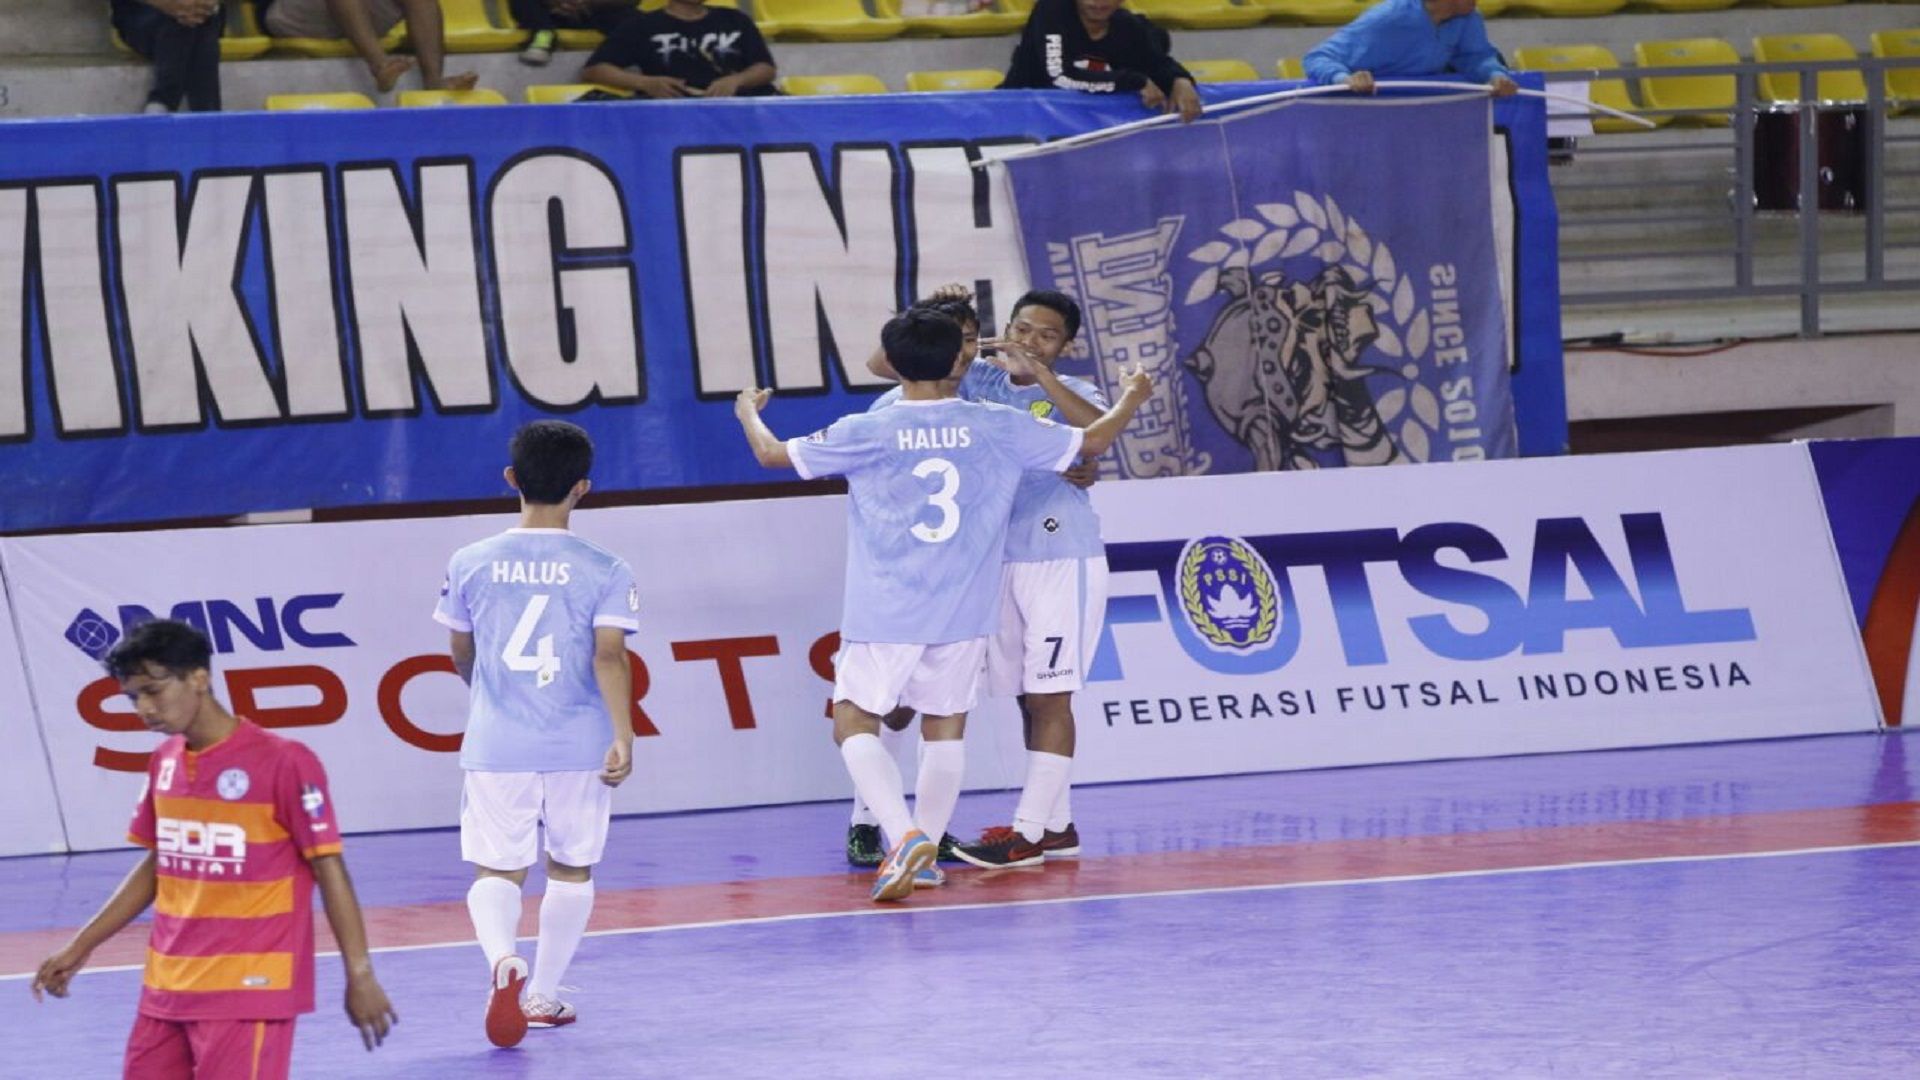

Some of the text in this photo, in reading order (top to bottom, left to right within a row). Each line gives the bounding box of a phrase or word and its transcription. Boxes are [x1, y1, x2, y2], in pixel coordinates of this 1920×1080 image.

[897, 427, 971, 450] HALUS
[910, 457, 961, 543] 3
[491, 560, 572, 586] HALUS
[1203, 568, 1247, 587] PSSI
[1086, 512, 1757, 682] FUTSAL
[501, 594, 562, 689] 4
[1043, 636, 1064, 669] 7
[1102, 660, 1752, 727] FEDERASI FUTSAL INDONESIA
[156, 817, 247, 859] SDR
